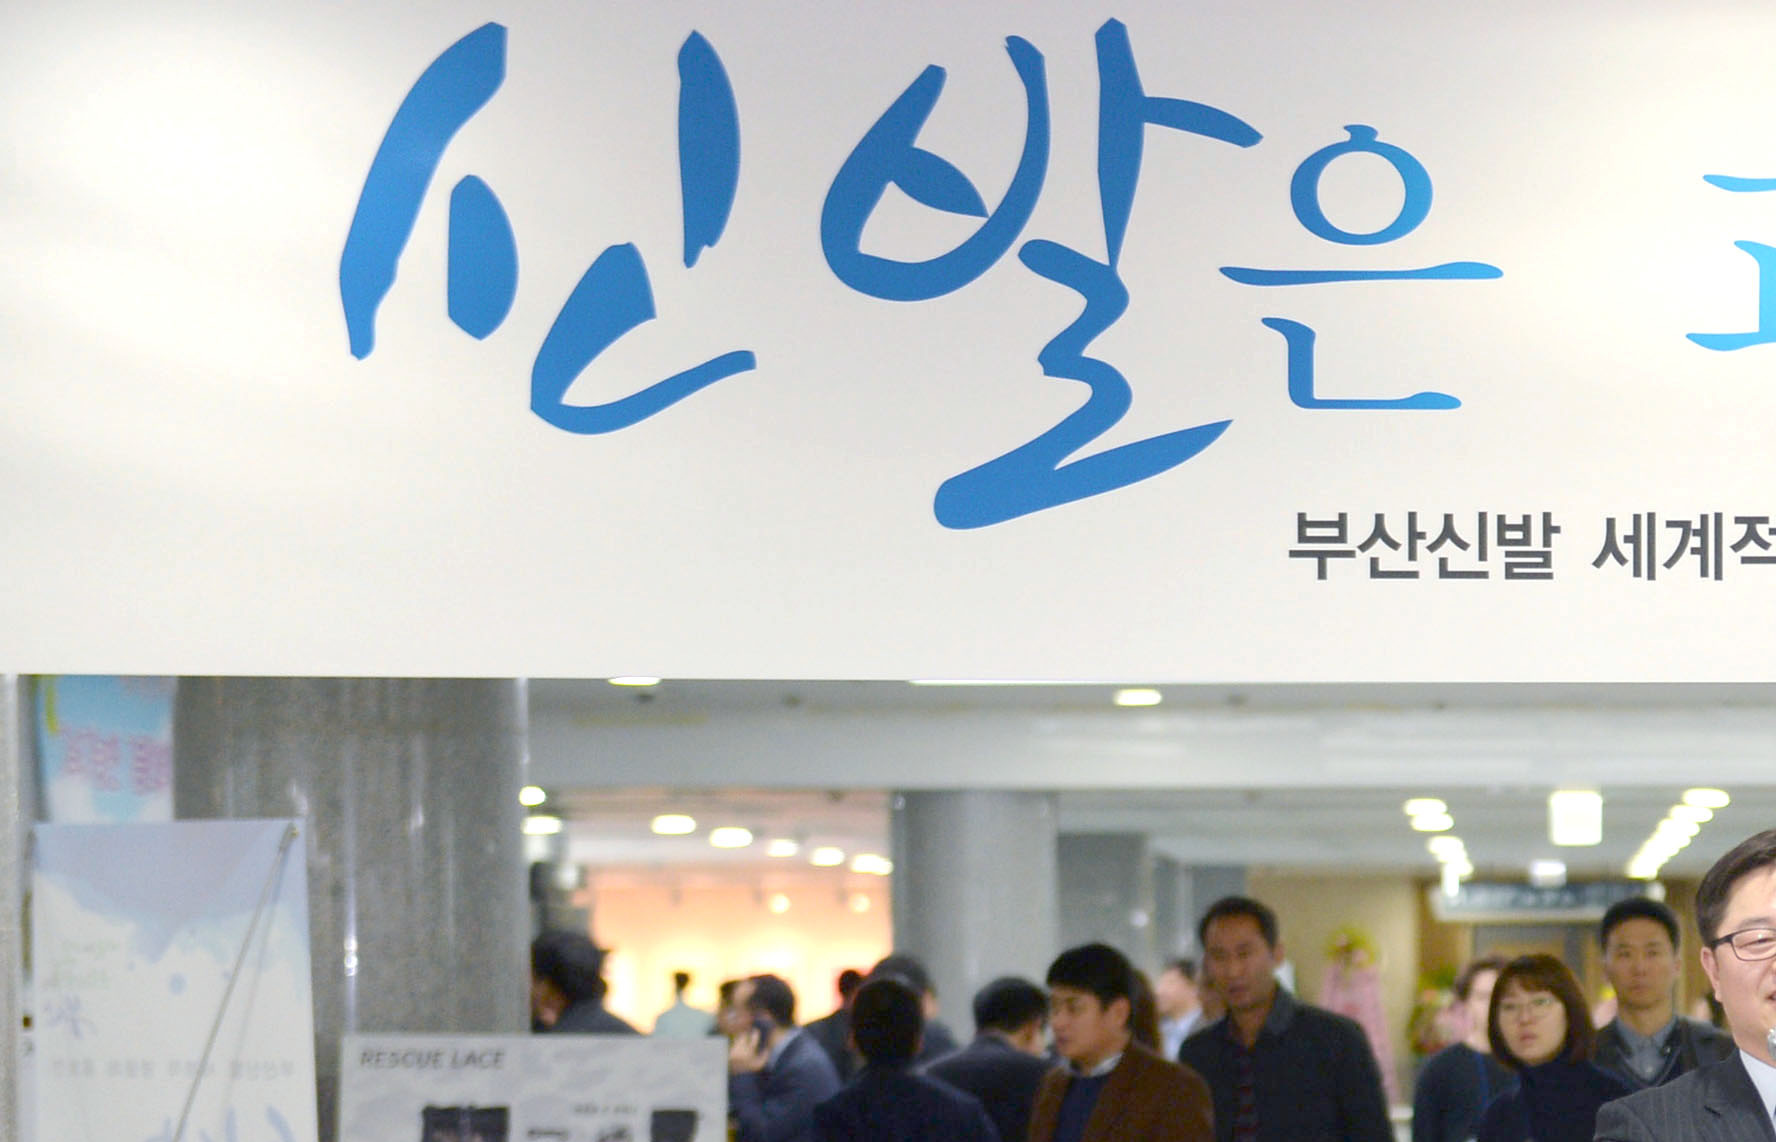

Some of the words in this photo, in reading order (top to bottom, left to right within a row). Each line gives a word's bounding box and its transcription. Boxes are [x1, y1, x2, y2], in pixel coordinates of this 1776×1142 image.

[339, 17, 1504, 531] 신발은
[1289, 510, 1562, 581] 부산신발
[360, 1050, 443, 1069] RESCUE
[451, 1050, 505, 1069] LACE
